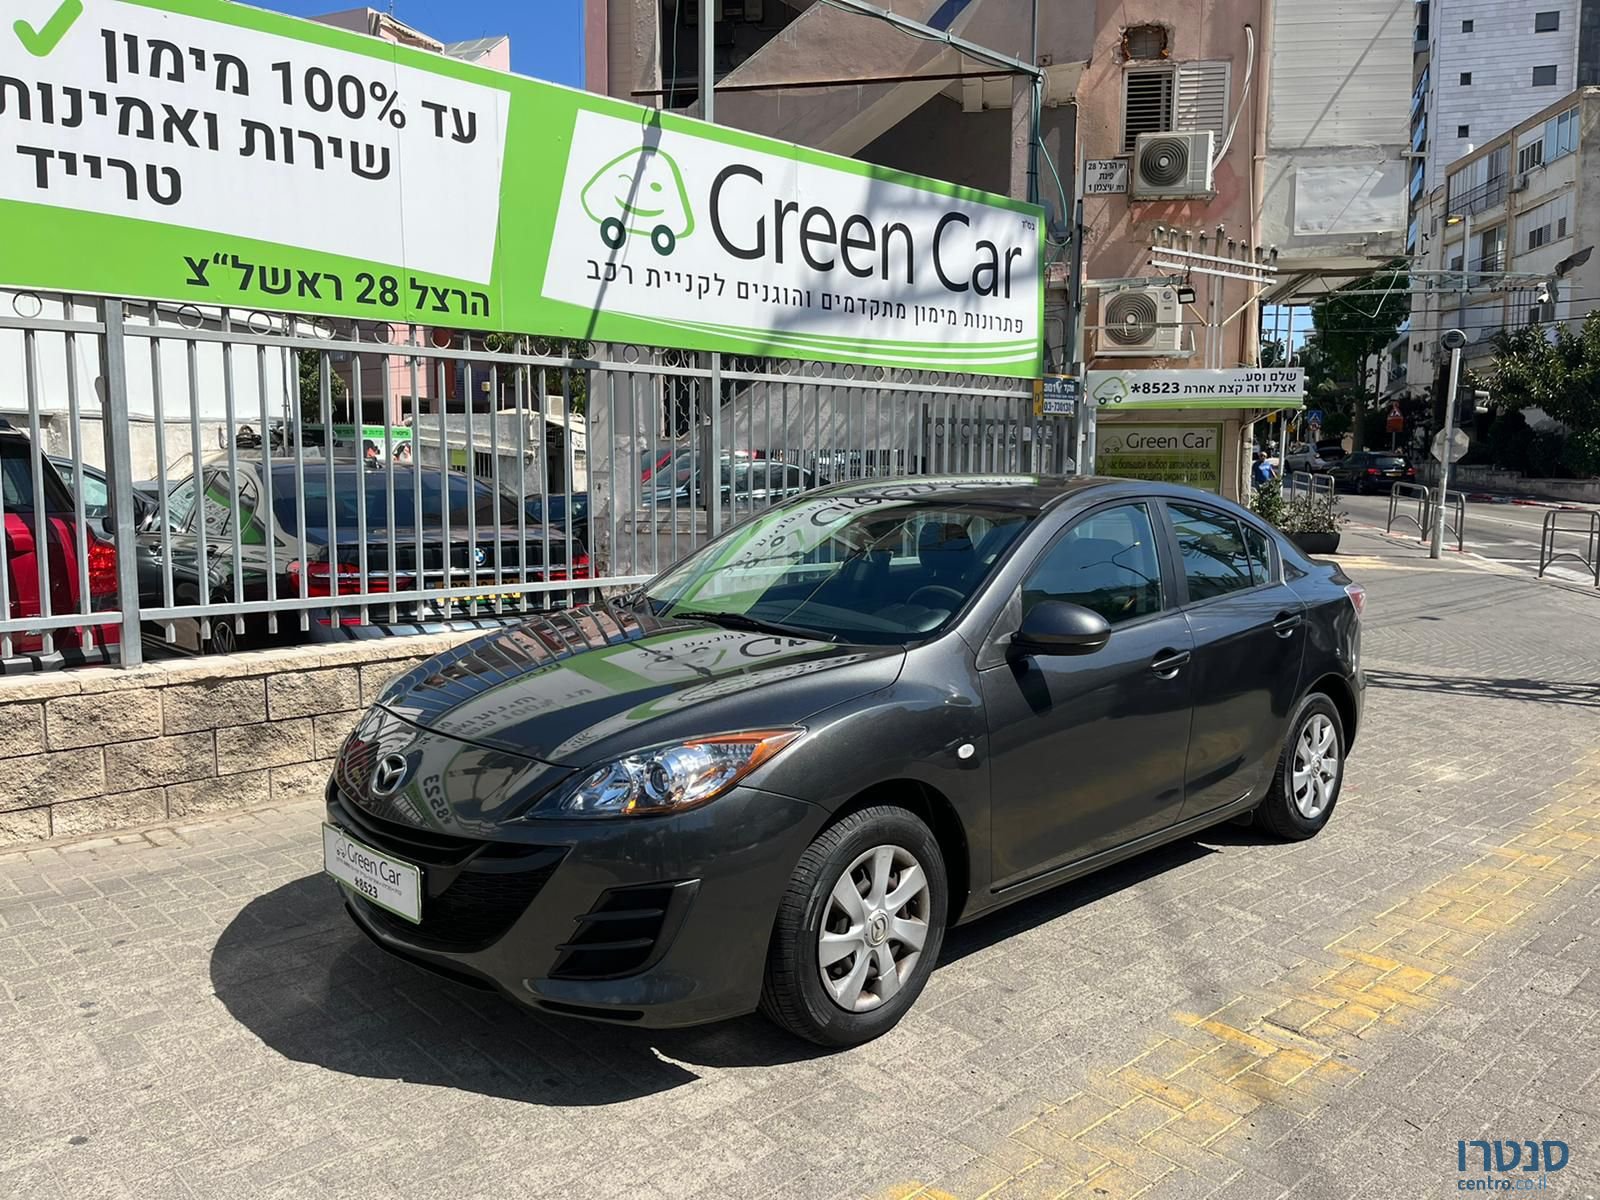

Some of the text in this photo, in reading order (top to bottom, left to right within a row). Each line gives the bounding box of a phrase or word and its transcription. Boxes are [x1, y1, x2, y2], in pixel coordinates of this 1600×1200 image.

[100, 28, 477, 144] עד 100% מימון
[0, 74, 391, 181] שירות ואמינות
[1088, 162, 1097, 170] 28
[1098, 161, 1118, 170] הרצל
[16, 143, 182, 206] טרייד
[1098, 172, 1115, 180] פינת
[708, 164, 1023, 299] Green Car
[354, 272, 399, 307] 28
[408, 277, 491, 317] הרצל
[586, 258, 1024, 335] פתרונות מימון מתקדמים והוגנים לקניית רכב
[1270, 371, 1297, 382] שלם
[1183, 384, 1216, 394] אחרת
[1218, 384, 1243, 396] קצת
[1246, 384, 1260, 393] זה
[1263, 382, 1297, 393] אצלנו
[1126, 432, 1213, 449] Green Car
[347, 843, 378, 876] Green
[379, 861, 402, 886] Car
